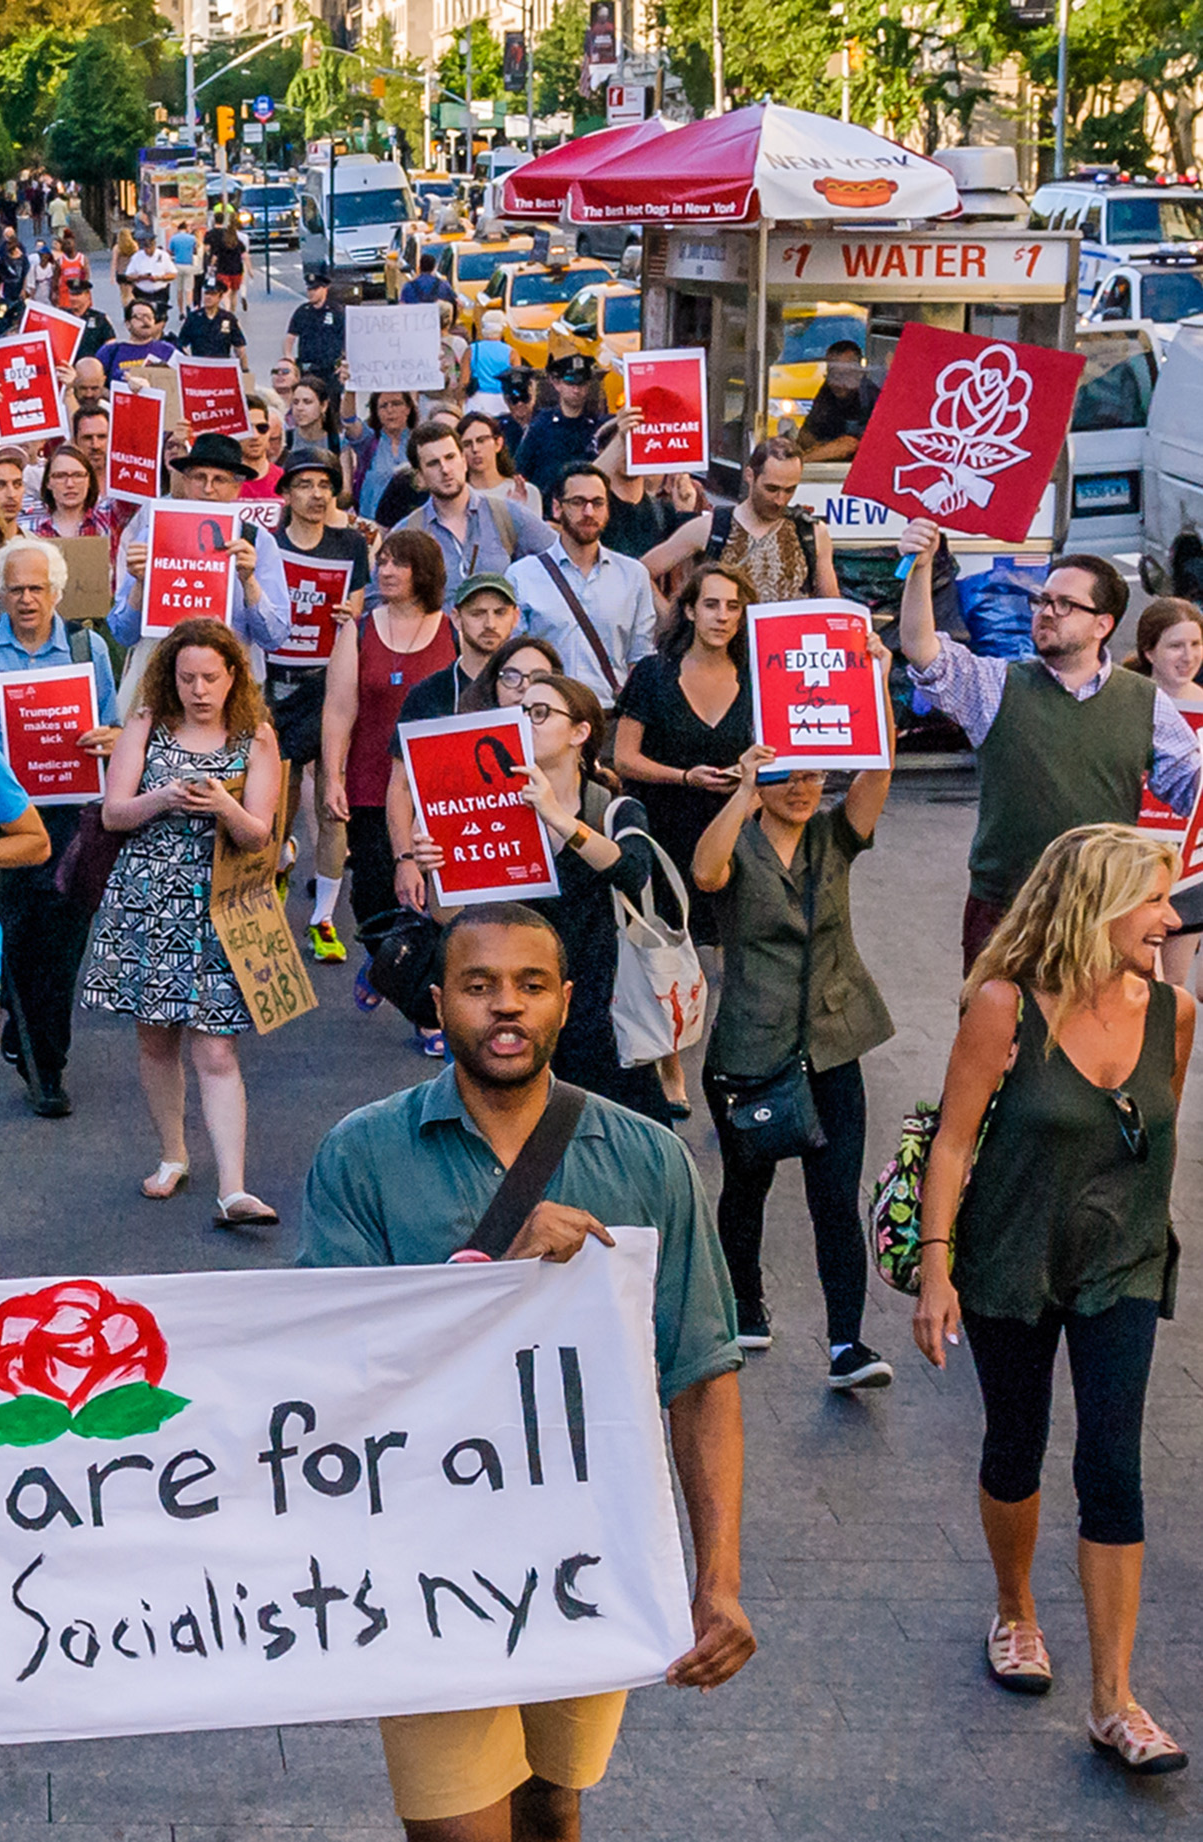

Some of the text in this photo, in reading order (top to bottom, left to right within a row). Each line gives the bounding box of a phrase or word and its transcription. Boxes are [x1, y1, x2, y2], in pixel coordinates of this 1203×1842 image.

[764, 152, 910, 171] NEW YORK
[515, 198, 534, 209] The
[583, 206, 603, 218] The
[605, 205, 625, 217] Best
[626, 205, 644, 216] Hot
[645, 204, 670, 217] Dogs
[685, 203, 710, 214] New
[712, 202, 737, 214] York
[782, 244, 813, 278] $1
[841, 244, 987, 278] WATER
[1013, 244, 1043, 278] $1
[388, 337, 402, 354] 4
[191, 408, 235, 422] DEATH
[633, 422, 700, 435] HEALTHCARE
[644, 438, 690, 454] for ALL
[110, 451, 156, 470] HEALTHCARE
[133, 470, 149, 483] ALL
[826, 498, 889, 525] NEW
[154, 557, 226, 573] HEALTHCARE
[172, 577, 205, 589] is a
[161, 593, 212, 608] RIGHT
[766, 652, 868, 669] MEDICARE
[19, 705, 80, 719] Trumpcare
[23, 720, 78, 731] makes us
[795, 718, 849, 735] ALL
[40, 733, 63, 744] sick
[27, 760, 81, 771] Medicare
[38, 772, 73, 783] for all
[461, 821, 506, 835] is a
[453, 841, 521, 862] RIGHT
[254, 962, 309, 1026] BABY
[258, 1400, 408, 1515] for
[442, 1344, 588, 1492] all
[11, 1554, 388, 1683] Socialists
[418, 1554, 604, 1658] nyc
